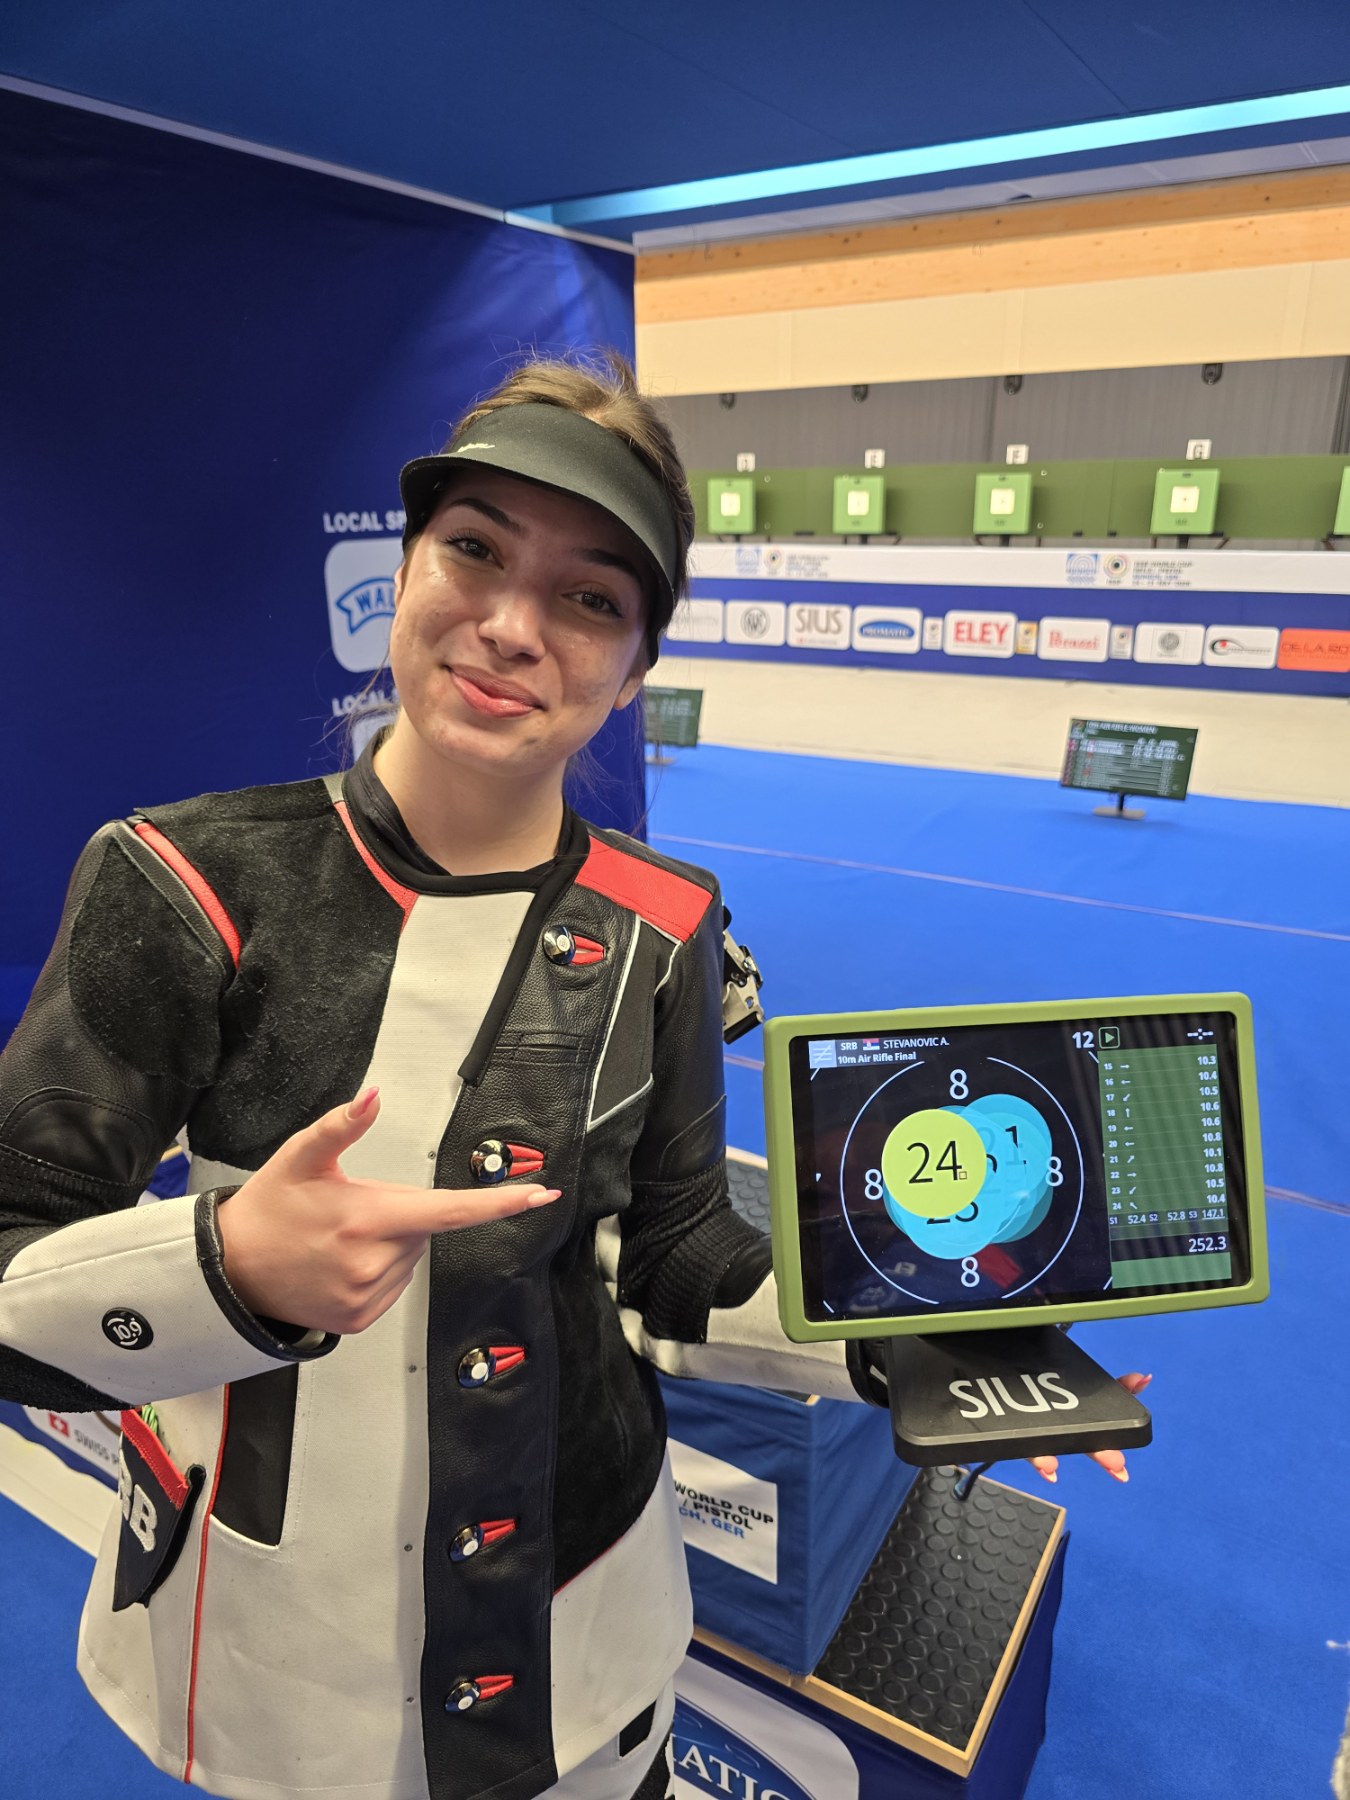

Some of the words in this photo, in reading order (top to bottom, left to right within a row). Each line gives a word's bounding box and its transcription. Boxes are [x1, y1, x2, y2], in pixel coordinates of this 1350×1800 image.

[323, 511, 384, 533] LOCAL
[795, 608, 843, 635] SIUS
[954, 621, 1009, 645] ELEY
[841, 1042, 858, 1051] SRB
[883, 1038, 939, 1049] STEVANOVIC
[940, 1037, 950, 1046] A.
[1072, 1031, 1095, 1049] 12
[838, 1055, 857, 1064] 10m
[858, 1054, 871, 1063] Air
[873, 1052, 893, 1062] Rifle
[895, 1051, 917, 1061] Final
[1197, 1056, 1217, 1065] 10.3
[950, 1068, 969, 1100] 8
[1105, 1078, 1114, 1086] 16
[1198, 1071, 1218, 1080] 10.4
[1200, 1087, 1219, 1096] 10.5
[1107, 1109, 1116, 1117] 18
[1200, 1102, 1220, 1111] 10.6
[1201, 1117, 1221, 1127] 10.6
[1109, 1140, 1118, 1148] 20
[1202, 1133, 1222, 1142] 10.8
[1203, 1148, 1222, 1158] 10.1
[906, 1140, 963, 1184] 24
[1045, 1156, 1064, 1187] 8
[1110, 1171, 1120, 1179] 22
[1205, 1163, 1224, 1173] 10.8
[864, 1168, 884, 1200] 8
[1205, 1178, 1225, 1188] 10.5
[1112, 1202, 1122, 1210] 24
[1206, 1194, 1226, 1203] 10.4
[1109, 1217, 1118, 1225] S1
[1127, 1214, 1146, 1224] 52.4
[1149, 1213, 1158, 1222] S2
[1167, 1211, 1186, 1221] 52.8
[1189, 1210, 1198, 1218] S3
[1202, 1208, 1224, 1218] 147.1
[1188, 1236, 1227, 1253] 252.3
[961, 1256, 980, 1288] 8
[948, 1372, 1079, 1419] SIUS
[74, 1428, 110, 1461] SWISS
[674, 1480, 732, 1510] WORLD
[738, 1505, 774, 1524] CUP
[693, 1501, 753, 1530] PISTOL
[711, 1517, 745, 1539] GER
